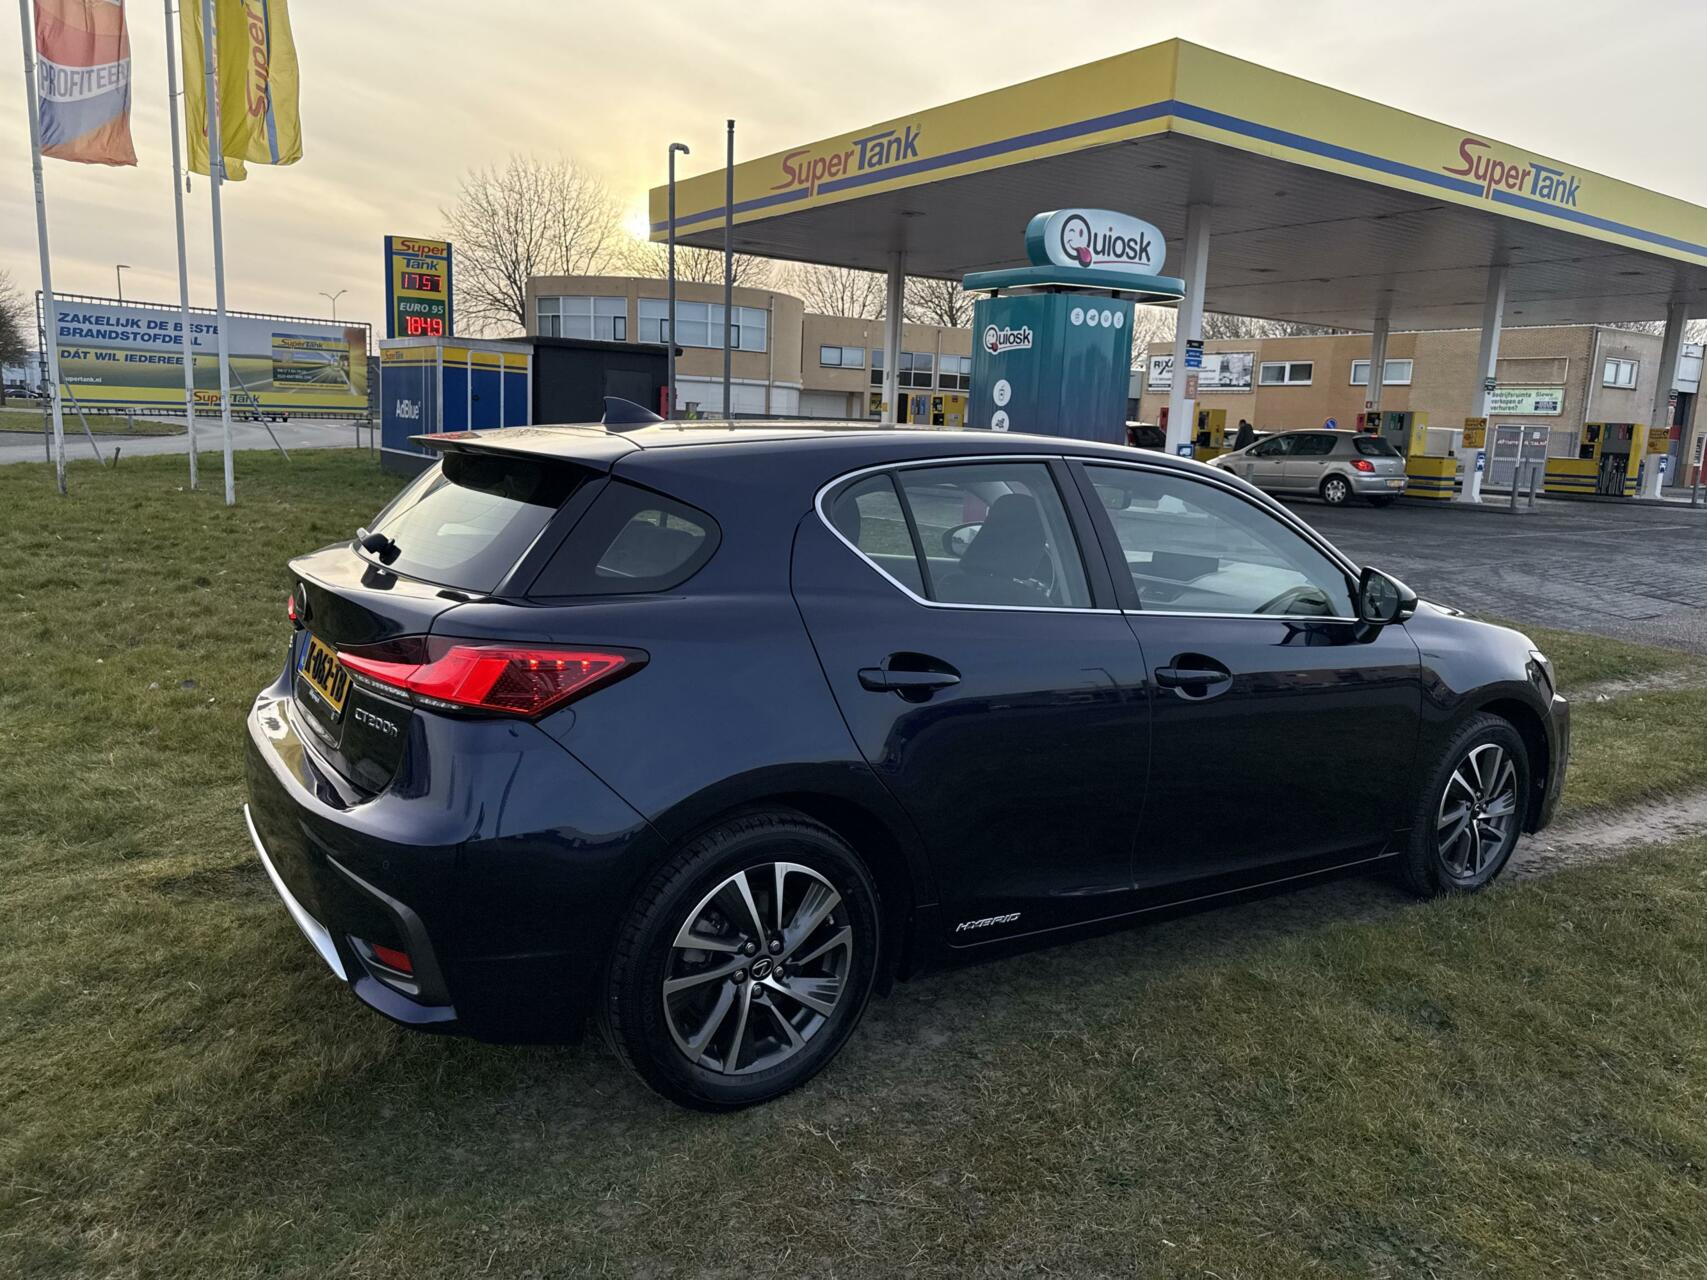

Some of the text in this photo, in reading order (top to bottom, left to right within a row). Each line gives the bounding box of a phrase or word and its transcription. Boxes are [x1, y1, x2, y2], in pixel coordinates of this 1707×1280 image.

[246, 0, 269, 140] Super
[394, 239, 446, 258] Super
[1061, 214, 1151, 267] Quiosk
[402, 257, 438, 271] Tank
[399, 302, 444, 314] EURO 95
[57, 312, 141, 329] ZAKELIJK
[146, 319, 168, 331] DE
[984, 326, 1031, 351] Quiosk
[60, 349, 197, 365] DÁT WIL IEDEREE!
[194, 391, 260, 407] SupTank
[395, 399, 421, 419] AdBlue
[354, 707, 398, 737] CT200h
[955, 912, 1021, 932] HYBRID
